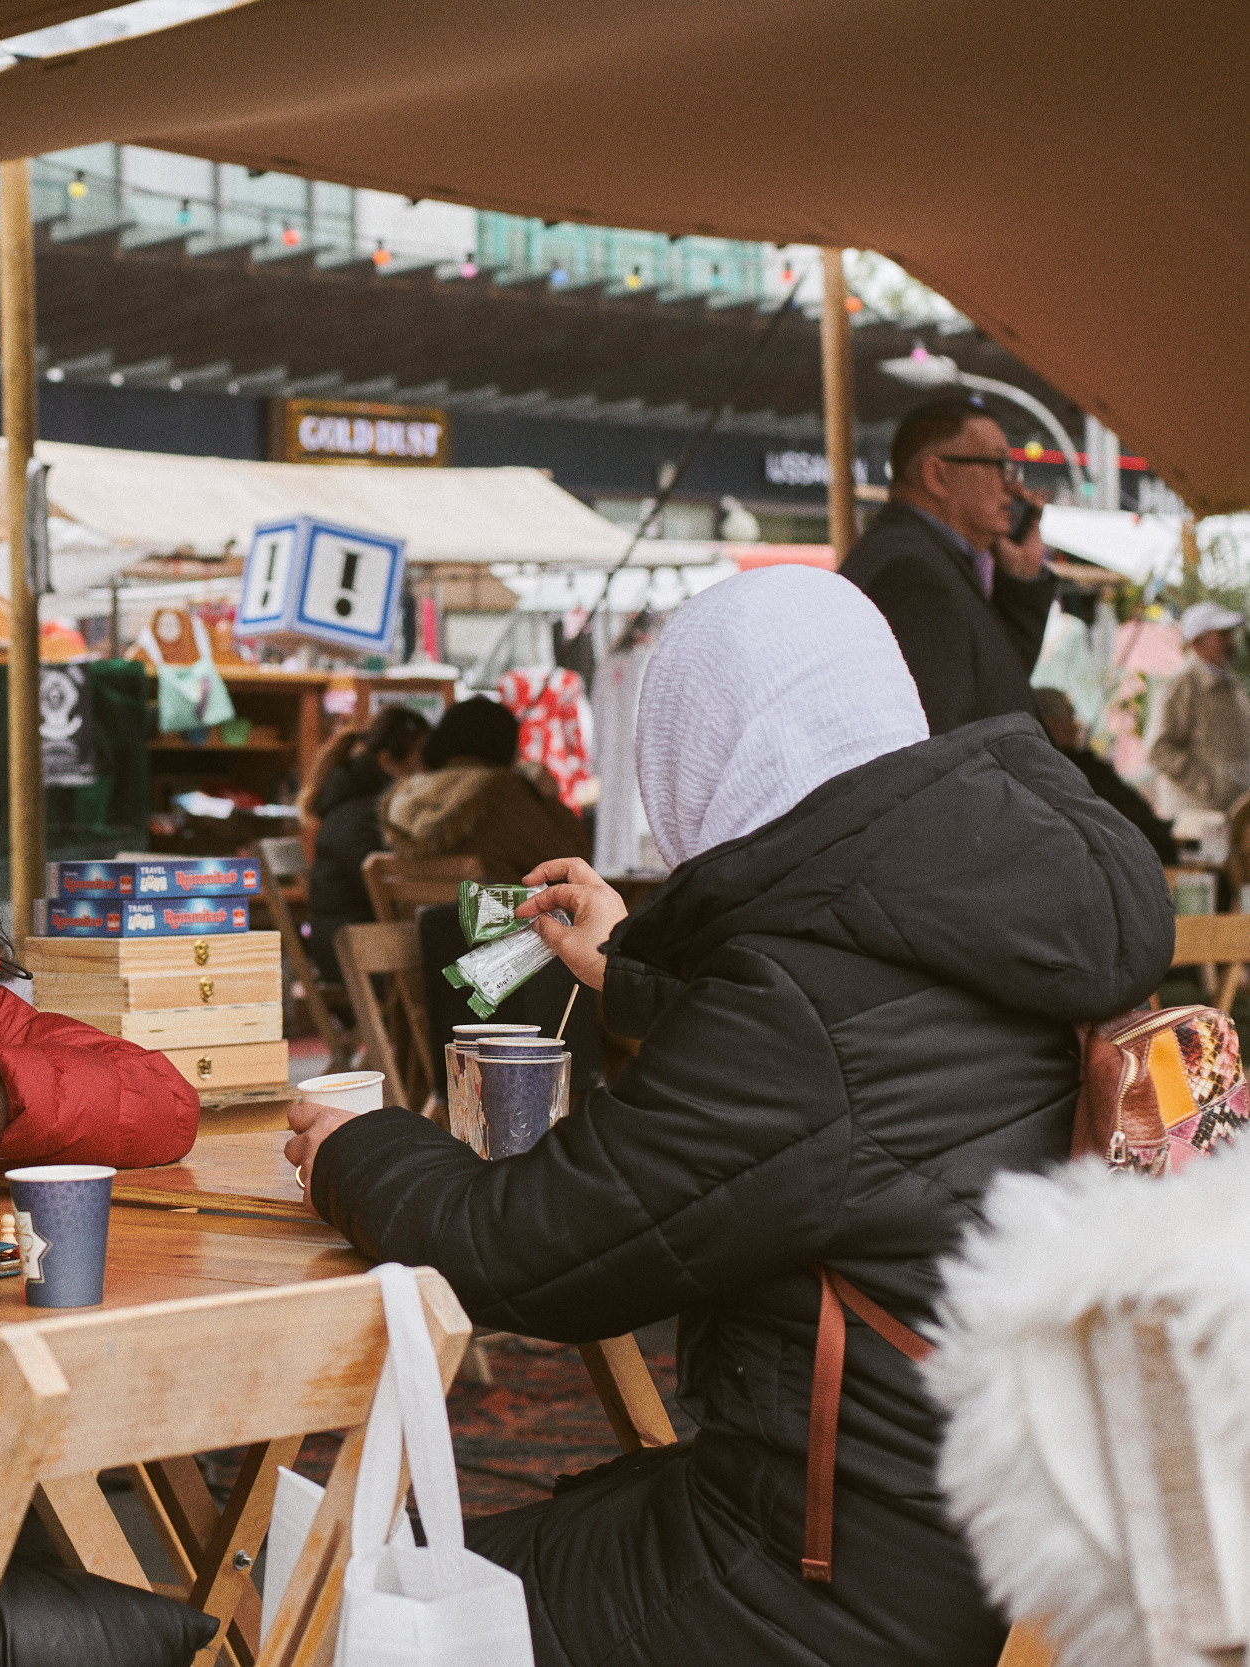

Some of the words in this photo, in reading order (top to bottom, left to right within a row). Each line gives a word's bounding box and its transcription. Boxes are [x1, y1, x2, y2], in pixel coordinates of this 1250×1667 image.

[140, 866, 166, 875] TRAVEL
[175, 868, 238, 892] Rummikub
[127, 904, 154, 913] TRAVEL
[163, 907, 227, 930] Rummikub
